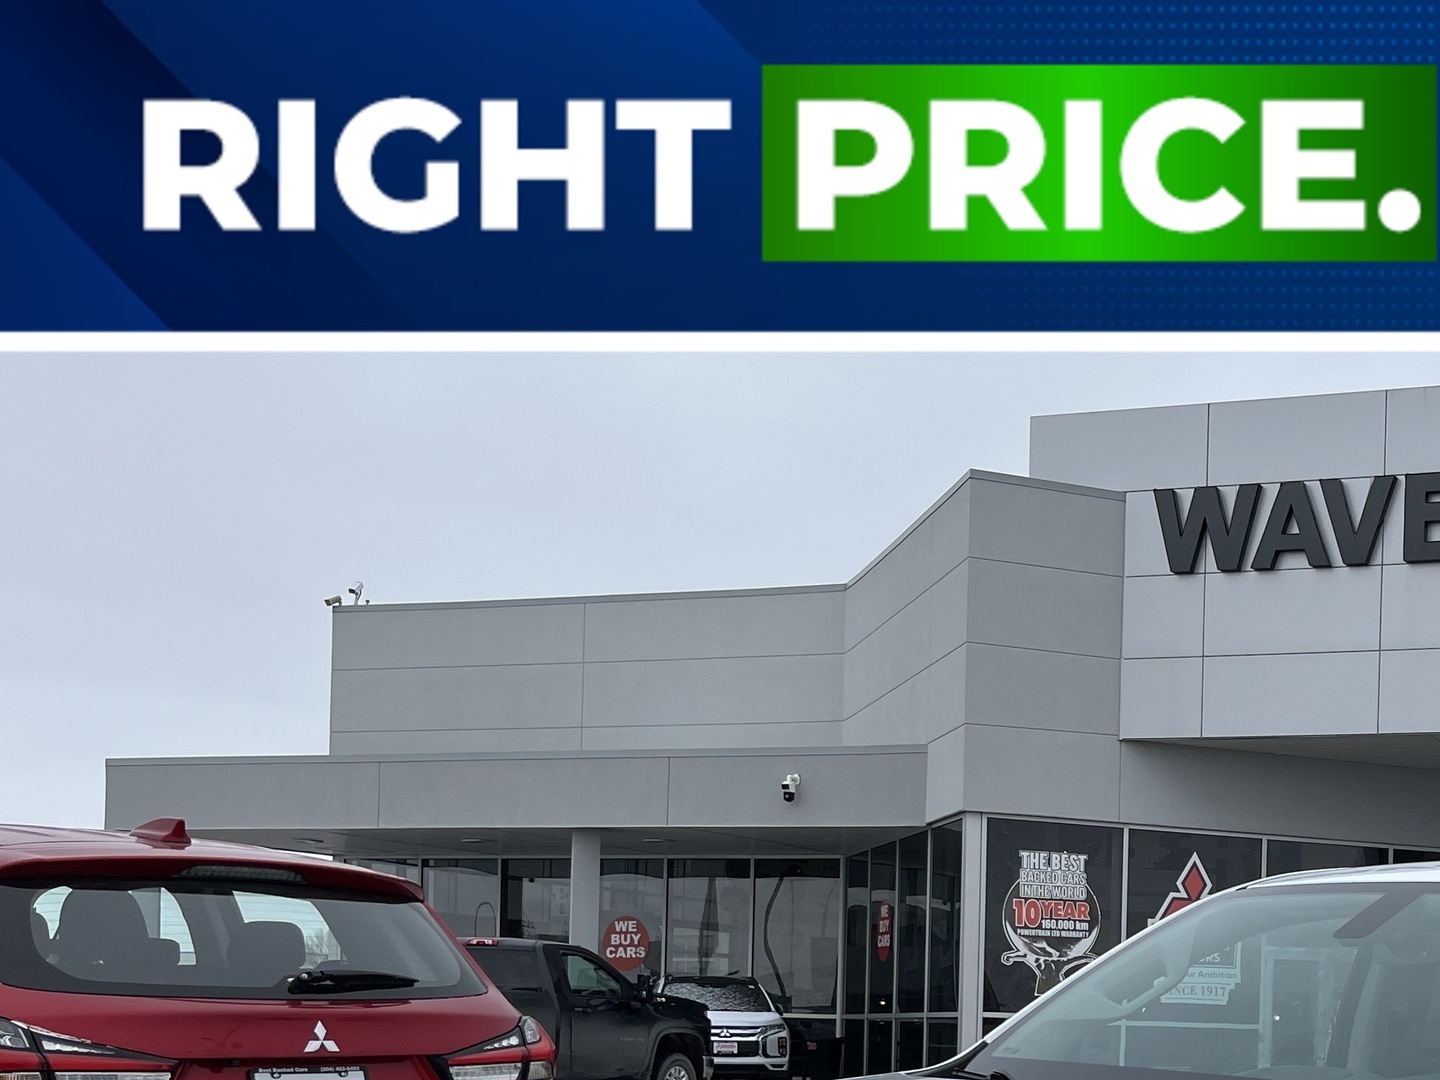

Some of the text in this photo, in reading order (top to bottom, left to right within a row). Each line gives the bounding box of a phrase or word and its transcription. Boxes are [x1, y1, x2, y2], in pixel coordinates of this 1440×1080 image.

[1020, 851, 1088, 873] THE BEST
[1021, 870, 1087, 885] BACKED CARS
[1021, 884, 1087, 899] IN THE WORLD
[1013, 898, 1090, 928] 10 YEAR
[614, 920, 638, 932] WE
[1076, 920, 1089, 931] km
[610, 933, 642, 945] BUY
[605, 947, 646, 958] CARS
[1198, 970, 1238, 979] Ambition
[1168, 985, 1226, 997] INCE 1917
